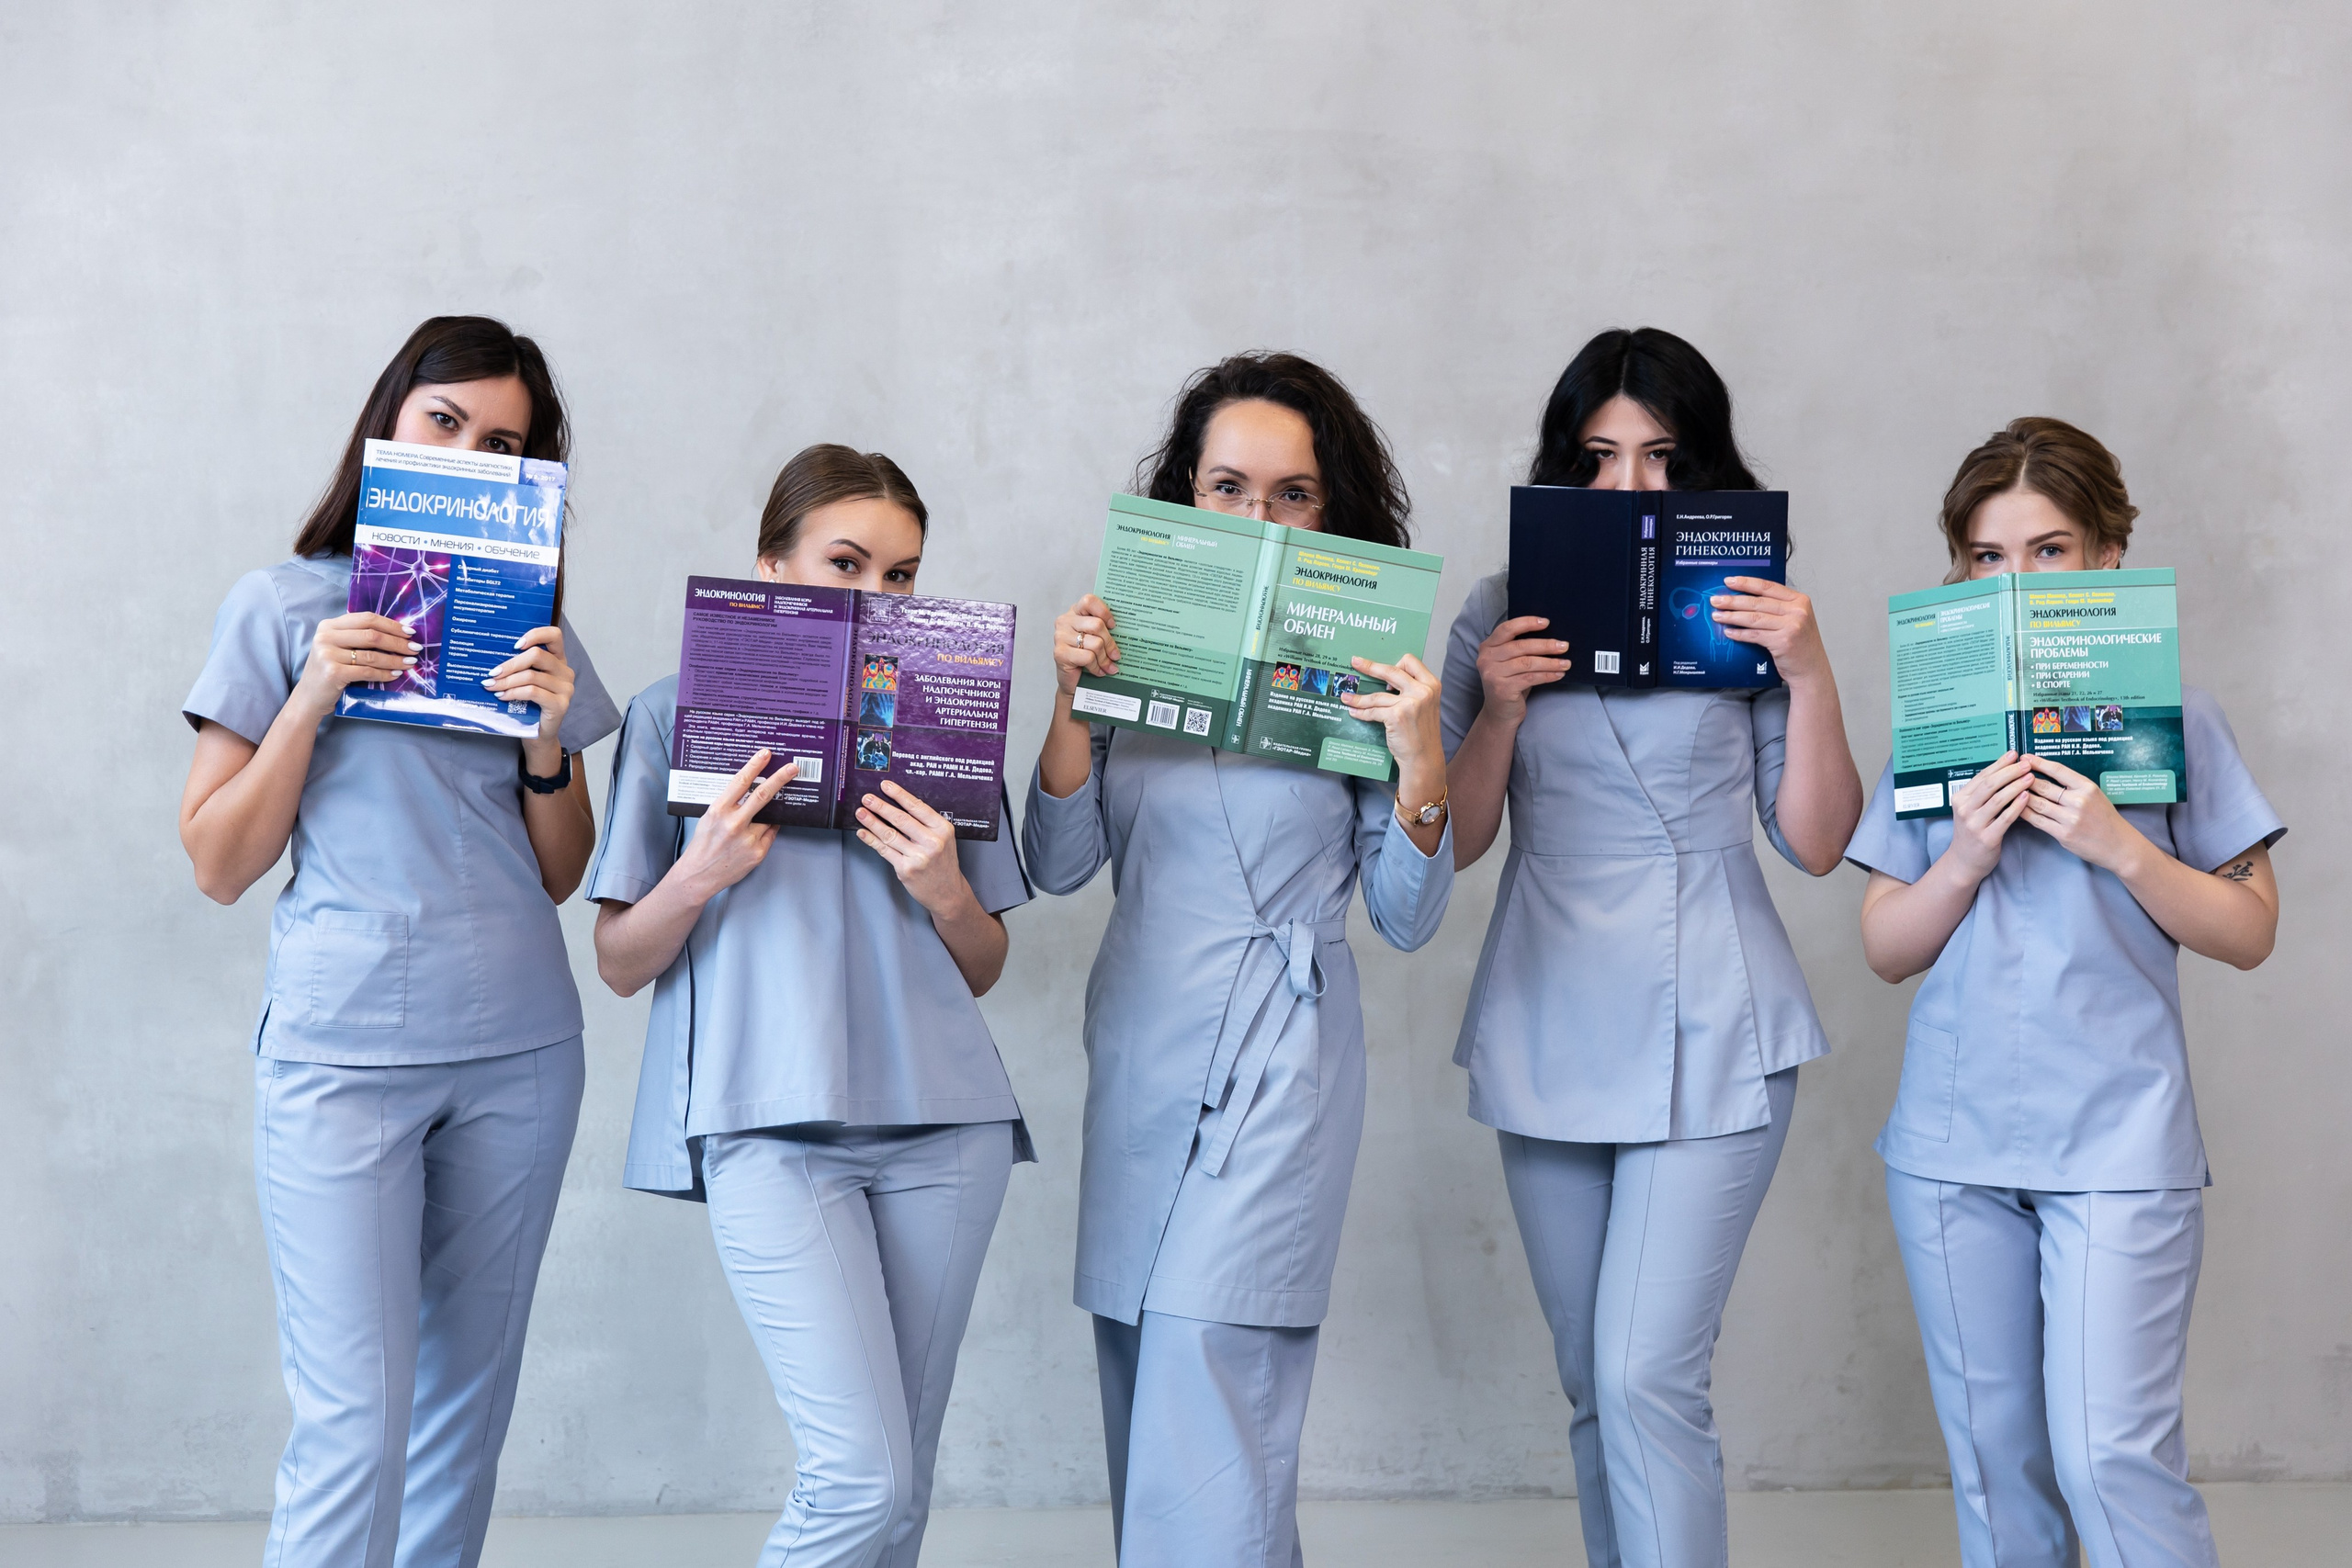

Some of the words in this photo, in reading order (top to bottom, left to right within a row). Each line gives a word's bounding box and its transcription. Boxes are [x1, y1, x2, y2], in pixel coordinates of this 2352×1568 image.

[376, 448, 392, 457] ТЕМА
[393, 450, 418, 459] НОМЕРА
[419, 453, 456, 464] Современные
[456, 458, 478, 467] аспекты
[479, 461, 514, 471] диагностики,
[368, 486, 550, 528] ЭНДОКРИНОЛОГИЯ
[371, 531, 421, 545] НОВОСТИ
[1115, 524, 1171, 540] ЭНДОКРИНОЛОГИЯ
[1676, 531, 1770, 544] ЭНДОКРИННАЯ
[1675, 545, 1770, 556] ГИНЕКОЛОГИЯ
[457, 563, 481, 572] Саарный
[481, 567, 500, 575] диабет
[1294, 565, 1378, 591] ЭНДОКРИНОЛОГИЯ
[1638, 547, 1648, 610] ЭНДОКРИННАЯ
[1646, 547, 1656, 610] ГИНЕКОЛОГИЯ
[1291, 577, 1304, 586] ПО
[1305, 579, 1341, 593] ВИЛЬЯМСУ
[455, 587, 494, 597] Метаболическая
[694, 587, 765, 603] ЭНДОКРИНОЛОГИЯ
[453, 598, 507, 610] Персонализированная
[1285, 597, 1397, 635] МИНЕРАЛЬНЫЙ
[2029, 606, 2117, 618] ЭНДОКРИНОЛОГИЯ
[451, 615, 477, 624] Ожирение
[2029, 620, 2041, 628] ПО
[2042, 619, 2081, 628] ВИЛЬЯМСУ
[450, 627, 490, 637] Субклинический
[490, 632, 521, 640] тиреотоксик
[1282, 616, 1336, 640] ОБМЕН
[448, 638, 474, 647] Эволюция
[865, 630, 1004, 655] ЭНДОКРИНОЛОГИЯ
[2029, 632, 2162, 648] ЭНДОКРИНОЛОГИЧЕСКИЕ
[2030, 646, 2088, 659] ПРОБЛЕМЫ
[936, 652, 952, 662] ПО
[954, 654, 1003, 667] ВИЛЬЯМСУ
[2035, 662, 2050, 671] ПРИ
[2052, 660, 2109, 670] БЕРЕМЕННОСТИ
[445, 669, 480, 677] интервальные
[2035, 671, 2051, 680] ПРИ
[2051, 670, 2089, 679] СТАРЕНИИ
[914, 673, 975, 686] ЗАБОЛЕВАНИЯ
[977, 679, 1001, 689] КОРЫ
[2042, 680, 2071, 689] СПОРТЕ
[922, 684, 1001, 699] НАДПОЧЕЧНИКОВ
[933, 696, 999, 709] ЭНДОКРИННАЯ
[934, 706, 999, 719] АРТЕРИАЛЬНАЯ
[939, 717, 998, 729] ГИПЕРТЕНЗИЯ
